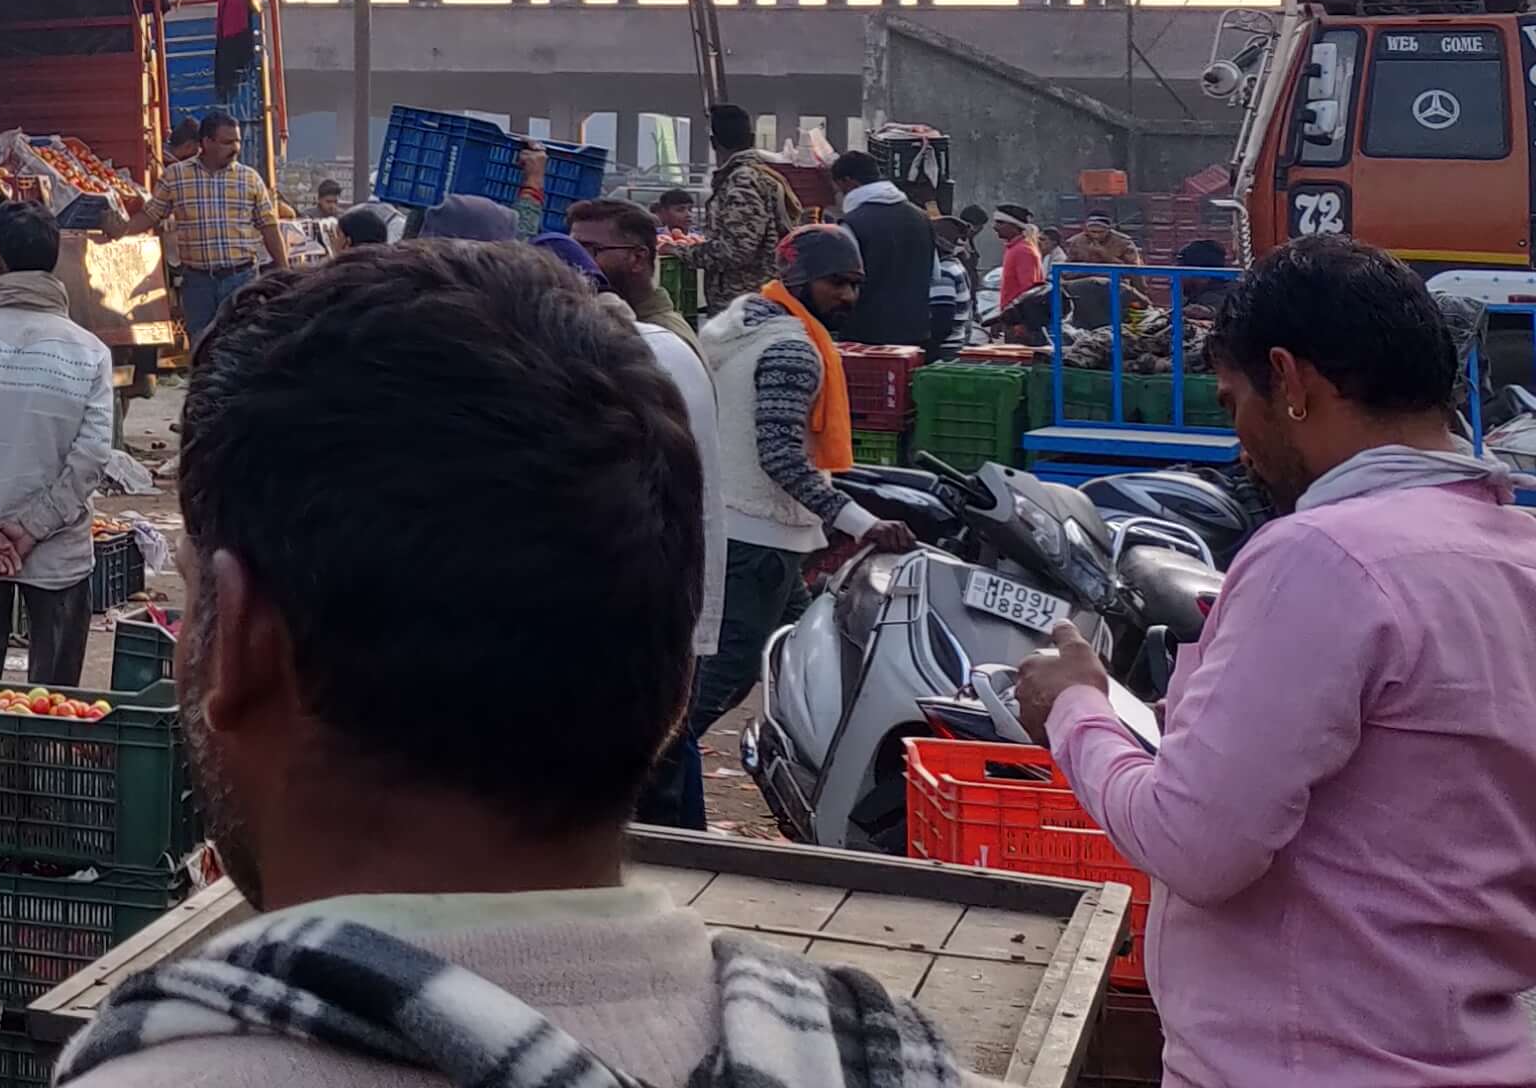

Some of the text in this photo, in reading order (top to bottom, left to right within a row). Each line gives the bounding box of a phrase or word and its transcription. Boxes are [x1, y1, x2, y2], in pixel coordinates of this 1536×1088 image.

[1294, 191, 1345, 236] 72
[983, 591, 1053, 628] U8827
[986, 577, 1057, 614] MP09U
